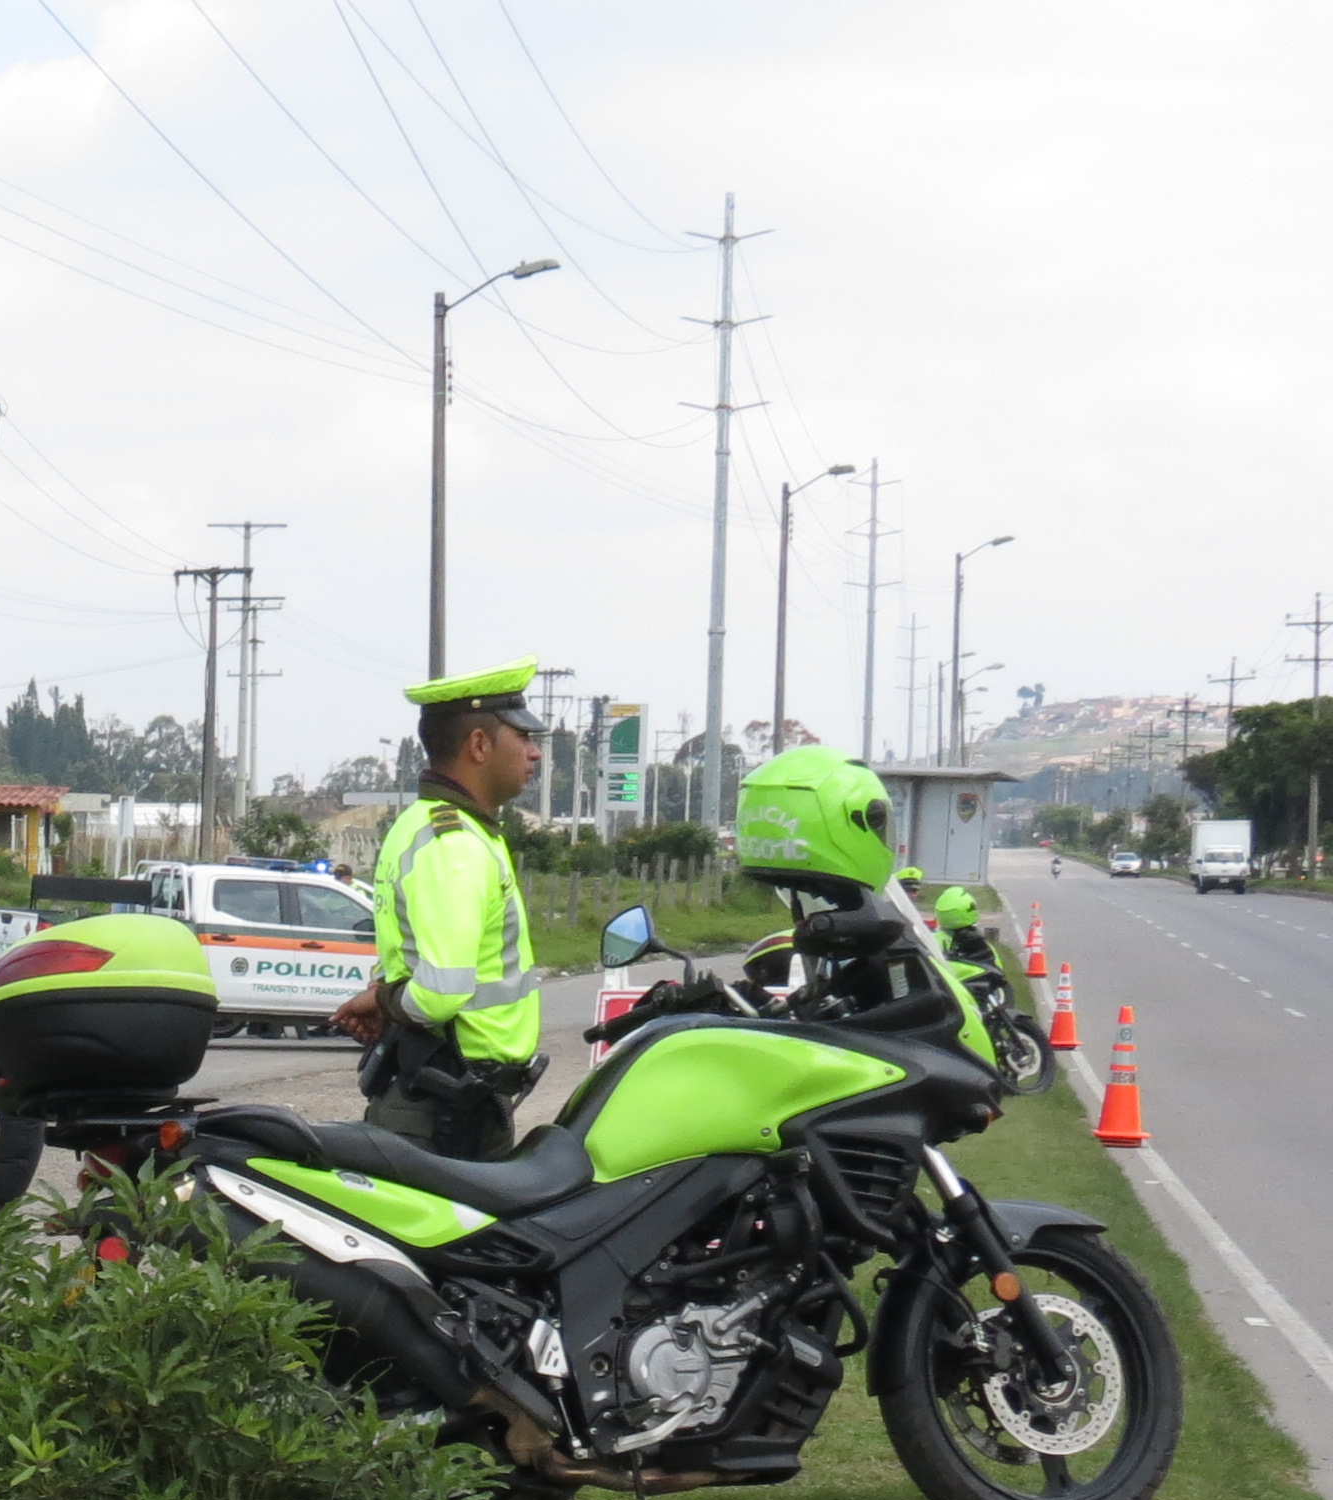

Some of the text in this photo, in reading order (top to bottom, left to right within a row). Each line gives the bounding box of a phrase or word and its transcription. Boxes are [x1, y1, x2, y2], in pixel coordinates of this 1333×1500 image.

[256, 960, 363, 981] POLICIA
[252, 983, 299, 994] TRANSITO
[300, 986, 308, 994] Y
